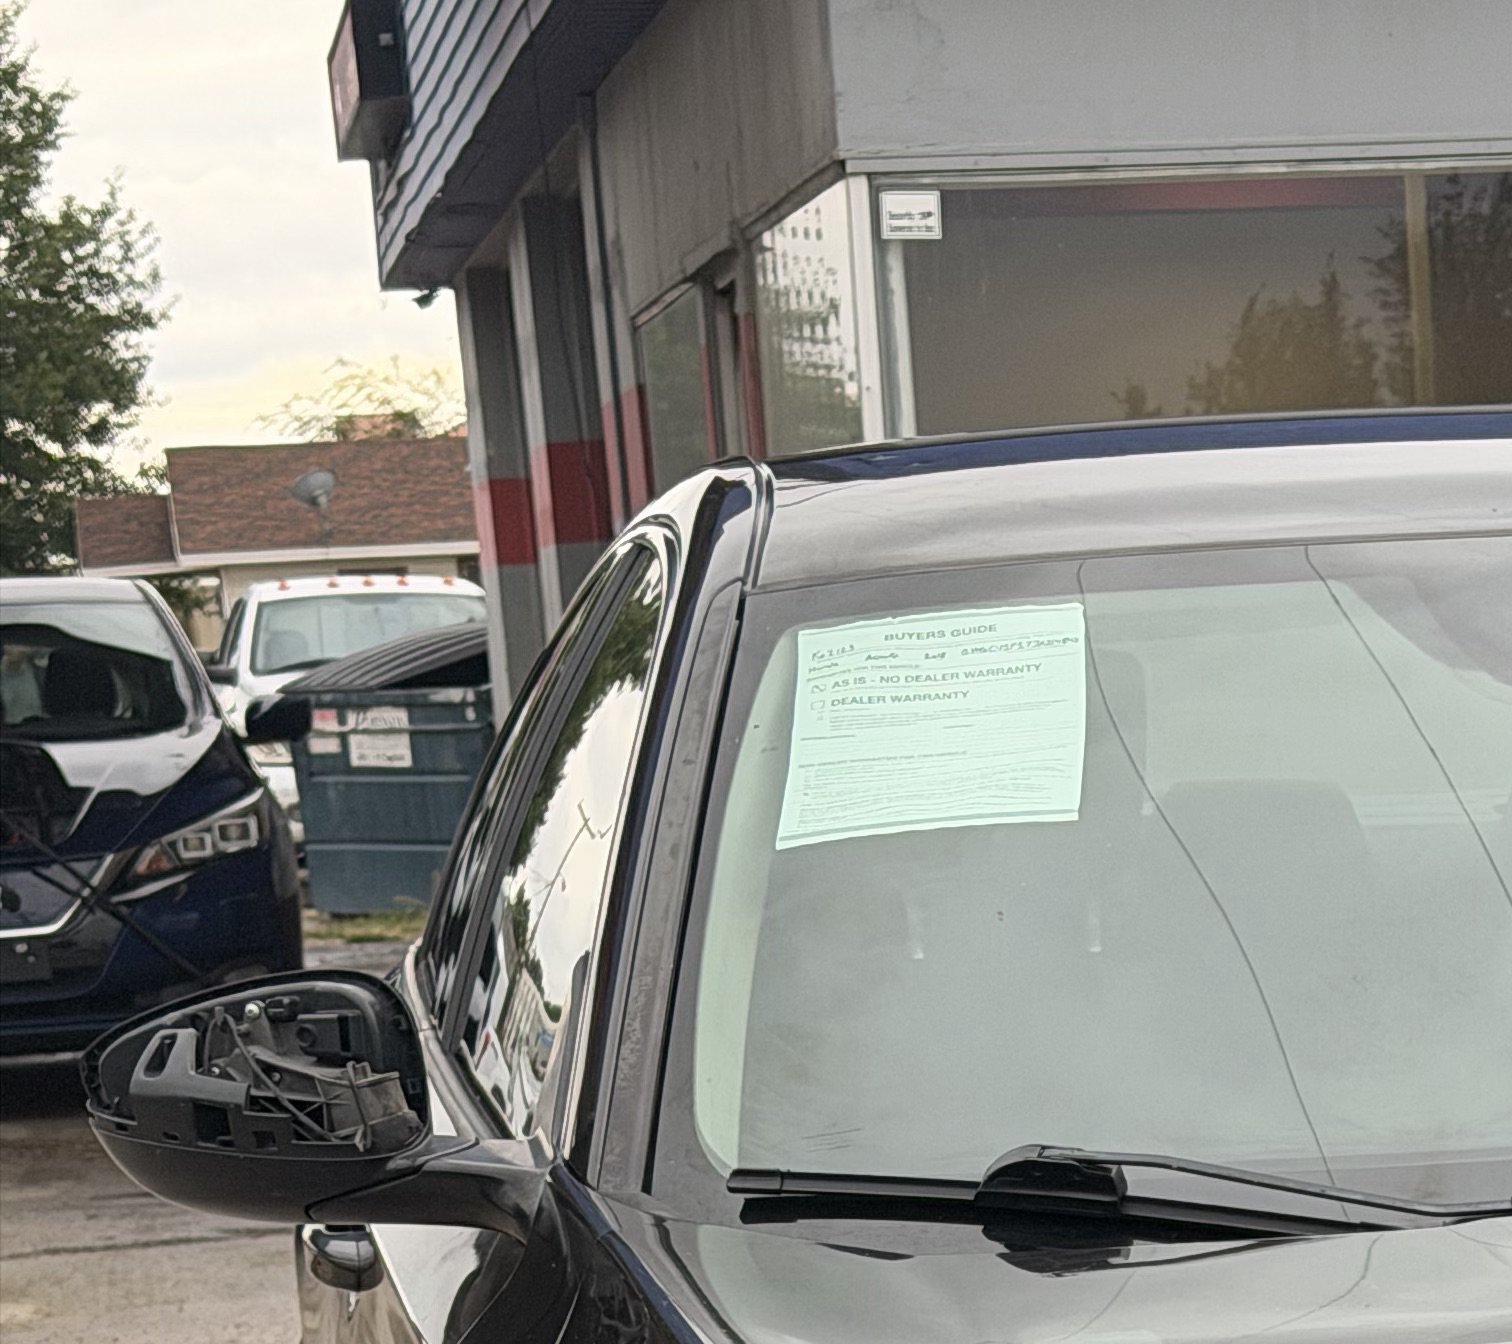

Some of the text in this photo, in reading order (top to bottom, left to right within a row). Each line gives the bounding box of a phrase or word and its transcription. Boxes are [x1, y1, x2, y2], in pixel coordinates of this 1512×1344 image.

[884, 624, 998, 642] BUYERS GUIDE
[831, 679, 850, 690] AS
[853, 676, 867, 685] IS
[879, 675, 901, 685] NO
[904, 672, 960, 684] DEALER
[963, 663, 1043, 679] WARRANTY
[831, 690, 970, 708] DEALER WARRANTY
